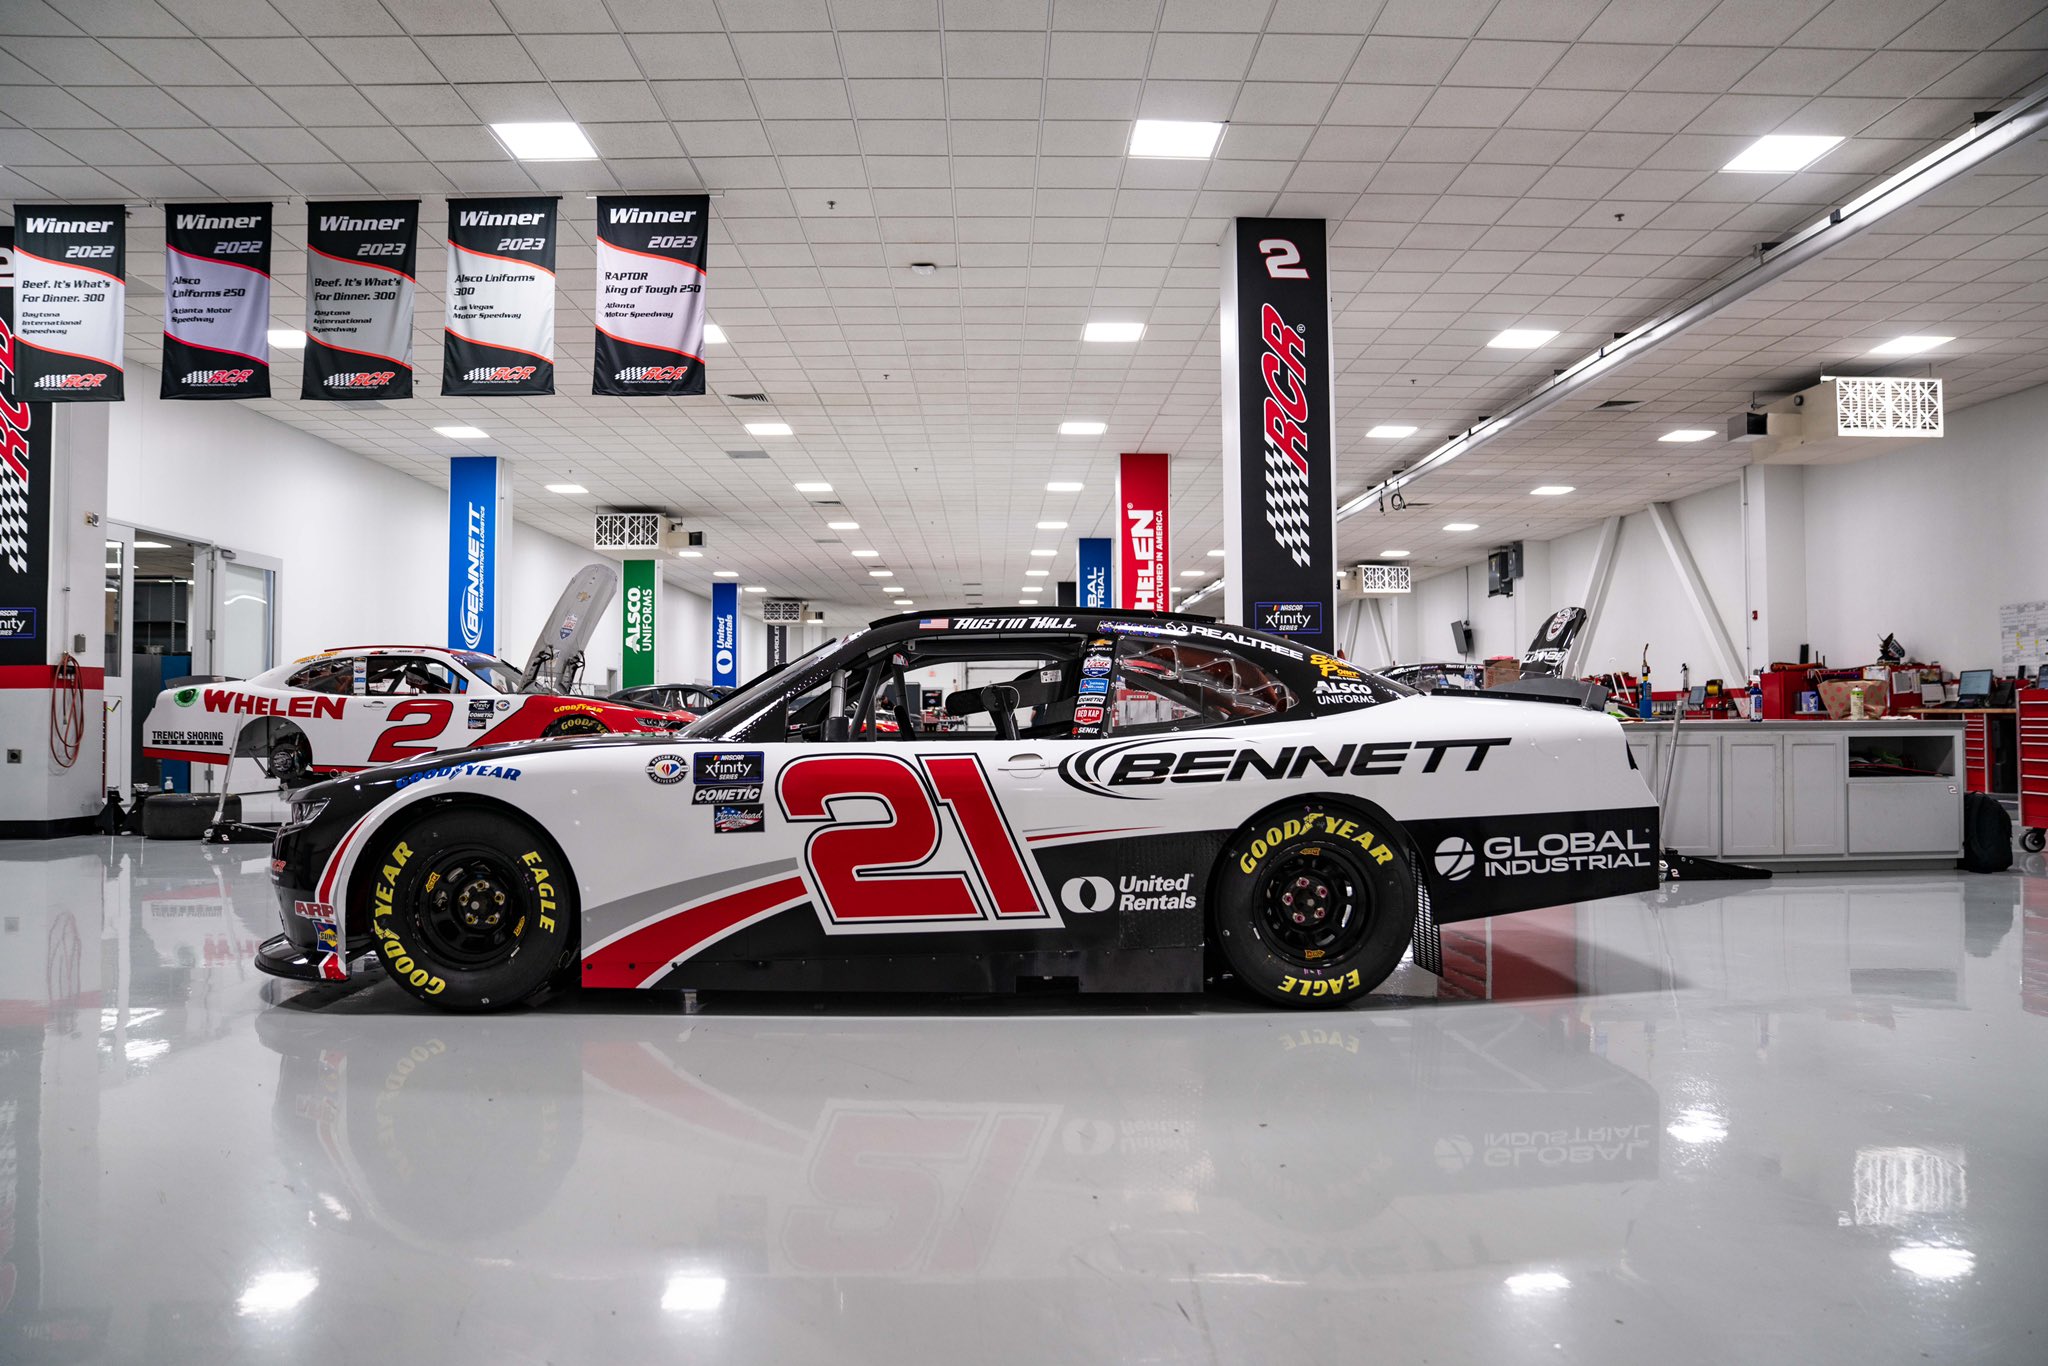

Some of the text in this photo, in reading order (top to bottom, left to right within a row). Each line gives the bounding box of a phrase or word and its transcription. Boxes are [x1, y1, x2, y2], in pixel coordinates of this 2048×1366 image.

[176, 214, 262, 230] Winner
[320, 216, 405, 231] Winner
[460, 211, 545, 227] Winner
[610, 208, 697, 224] Winner
[26, 217, 114, 233] Winner
[213, 241, 263, 254] 2022
[357, 243, 406, 256] 2023
[497, 238, 546, 251] 2023
[647, 236, 698, 249] 2023
[65, 245, 115, 258] 2022
[1259, 239, 1310, 279] 2
[22, 280, 111, 288] Beef. It's What's
[172, 276, 201, 285] Alsco
[314, 278, 401, 287] Beef. It's What's
[454, 274, 536, 283] Alsco Uniforms
[604, 271, 649, 281] RAPTOR
[22, 293, 105, 302] For Dinner. 300
[172, 288, 246, 298] Uniforms 250
[315, 291, 396, 301] For Dinner. 300
[453, 287, 475, 296] 300
[605, 284, 702, 296] King of Tough 250
[1262, 303, 1308, 478] RCR
[1155, 510, 1163, 550] AMERICA
[467, 501, 481, 634] BENNETT
[1126, 509, 1155, 610] HELEN
[1087, 567, 1098, 608] BAL
[1097, 566, 1105, 608] TRIAL
[1156, 563, 1164, 612] FACTURED
[1280, 604, 1304, 612] NASCAR
[0, 617, 26, 632] nity
[625, 587, 641, 655] ALSCO
[642, 588, 653, 652] UNIFORMS
[953, 616, 1077, 630] AUSTIN HILL
[1265, 611, 1312, 628] xfinity
[716, 616, 726, 649] United
[725, 614, 733, 649] Rentals
[1191, 625, 1304, 661] REALTREE
[1312, 680, 1372, 694] ALSCO
[203, 688, 348, 720] WHELEN
[1317, 694, 1376, 705] UNIFORMS
[553, 703, 604, 713] GOODYEAR
[1077, 710, 1100, 718] RED KAP
[152, 731, 224, 740] TRENCH SHORING
[367, 698, 454, 763] 2
[705, 760, 752, 777] xfinity
[1108, 737, 1512, 787] BENNETT
[395, 761, 521, 789] GOODYEAR
[695, 788, 760, 801] COMETIC
[775, 752, 1051, 925] 21
[1240, 813, 1394, 874] GOODYEAR
[1483, 829, 1650, 860] GLOBAL
[1484, 852, 1651, 877] INDUSTRIAL
[1119, 873, 1190, 893] United
[521, 851, 556, 933] EAGLE
[295, 901, 334, 918] ARP
[1119, 892, 1197, 911] Rentals
[373, 841, 446, 995] GOODYEAR
[1277, 968, 1361, 997] EAGLE
